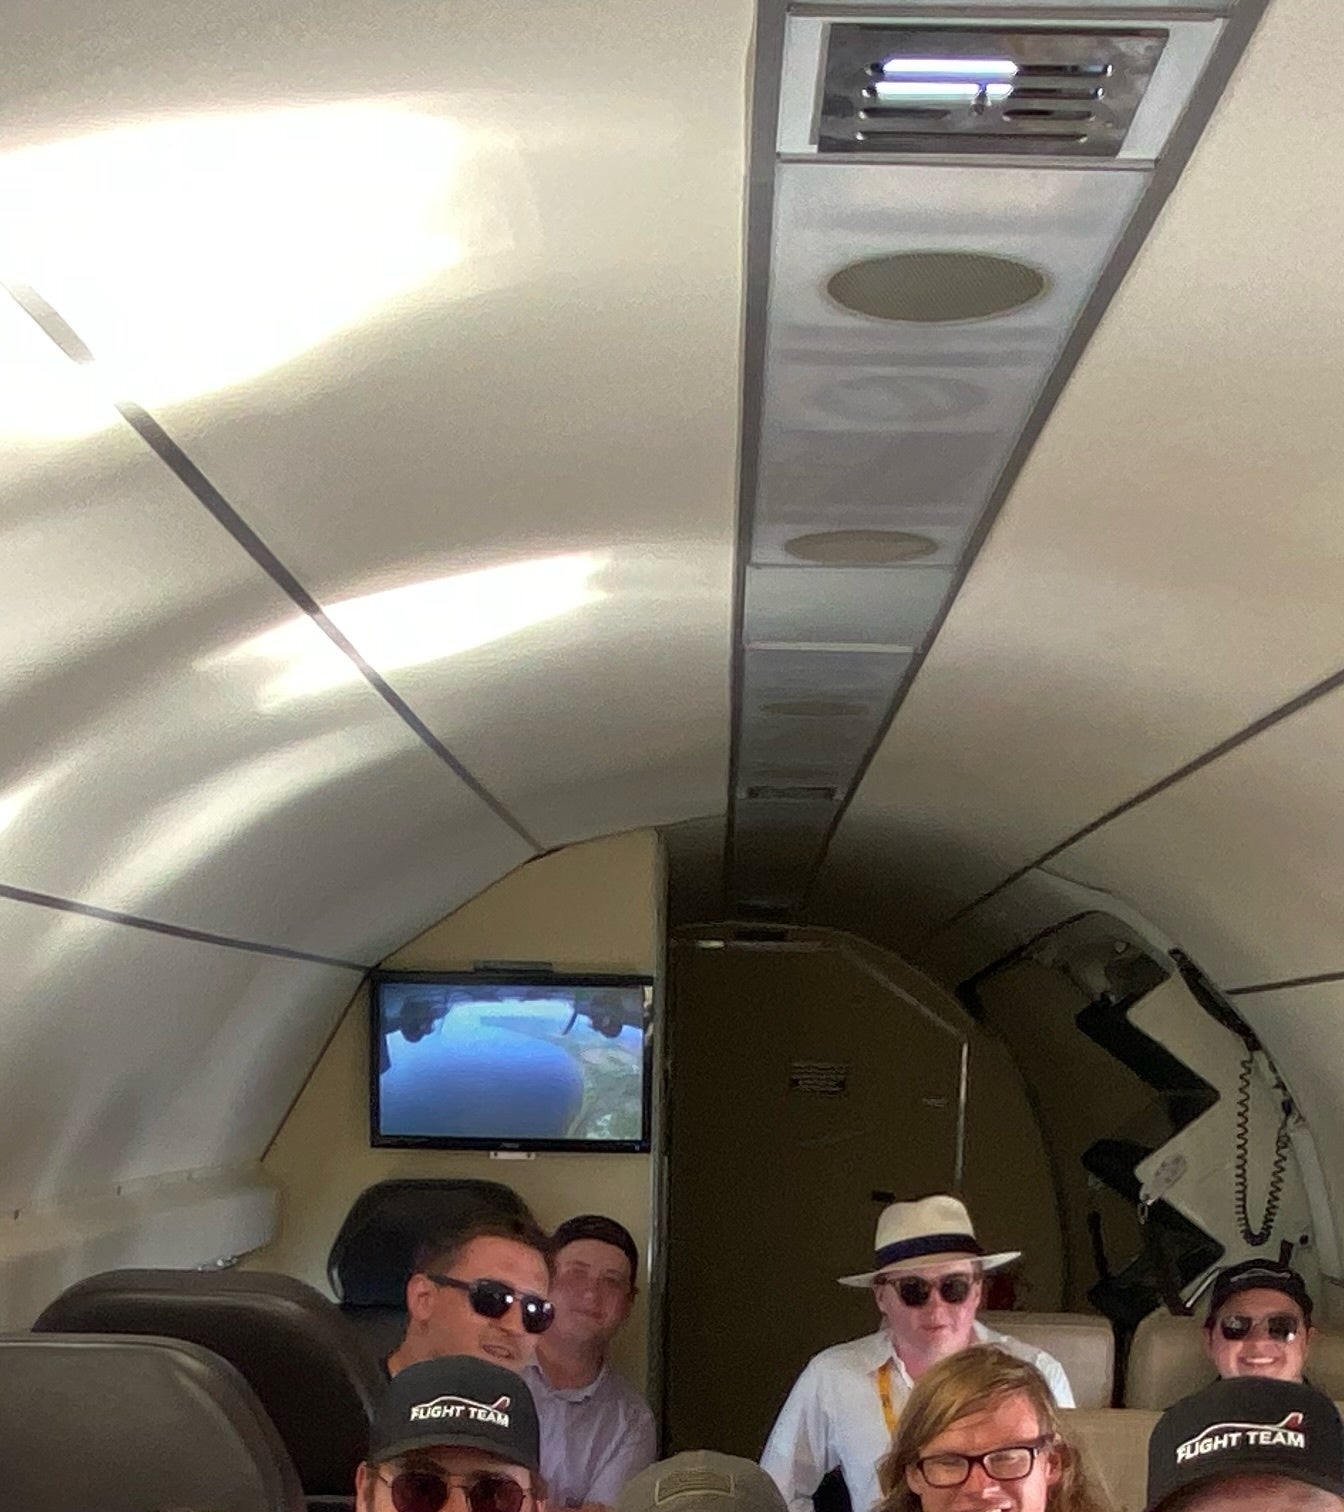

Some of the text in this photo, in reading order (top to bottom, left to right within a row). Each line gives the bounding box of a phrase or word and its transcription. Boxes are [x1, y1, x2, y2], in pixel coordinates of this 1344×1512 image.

[410, 1405, 509, 1428] FLIGHT TEAM
[1176, 1431, 1305, 1464] FLIGHT TEAM
